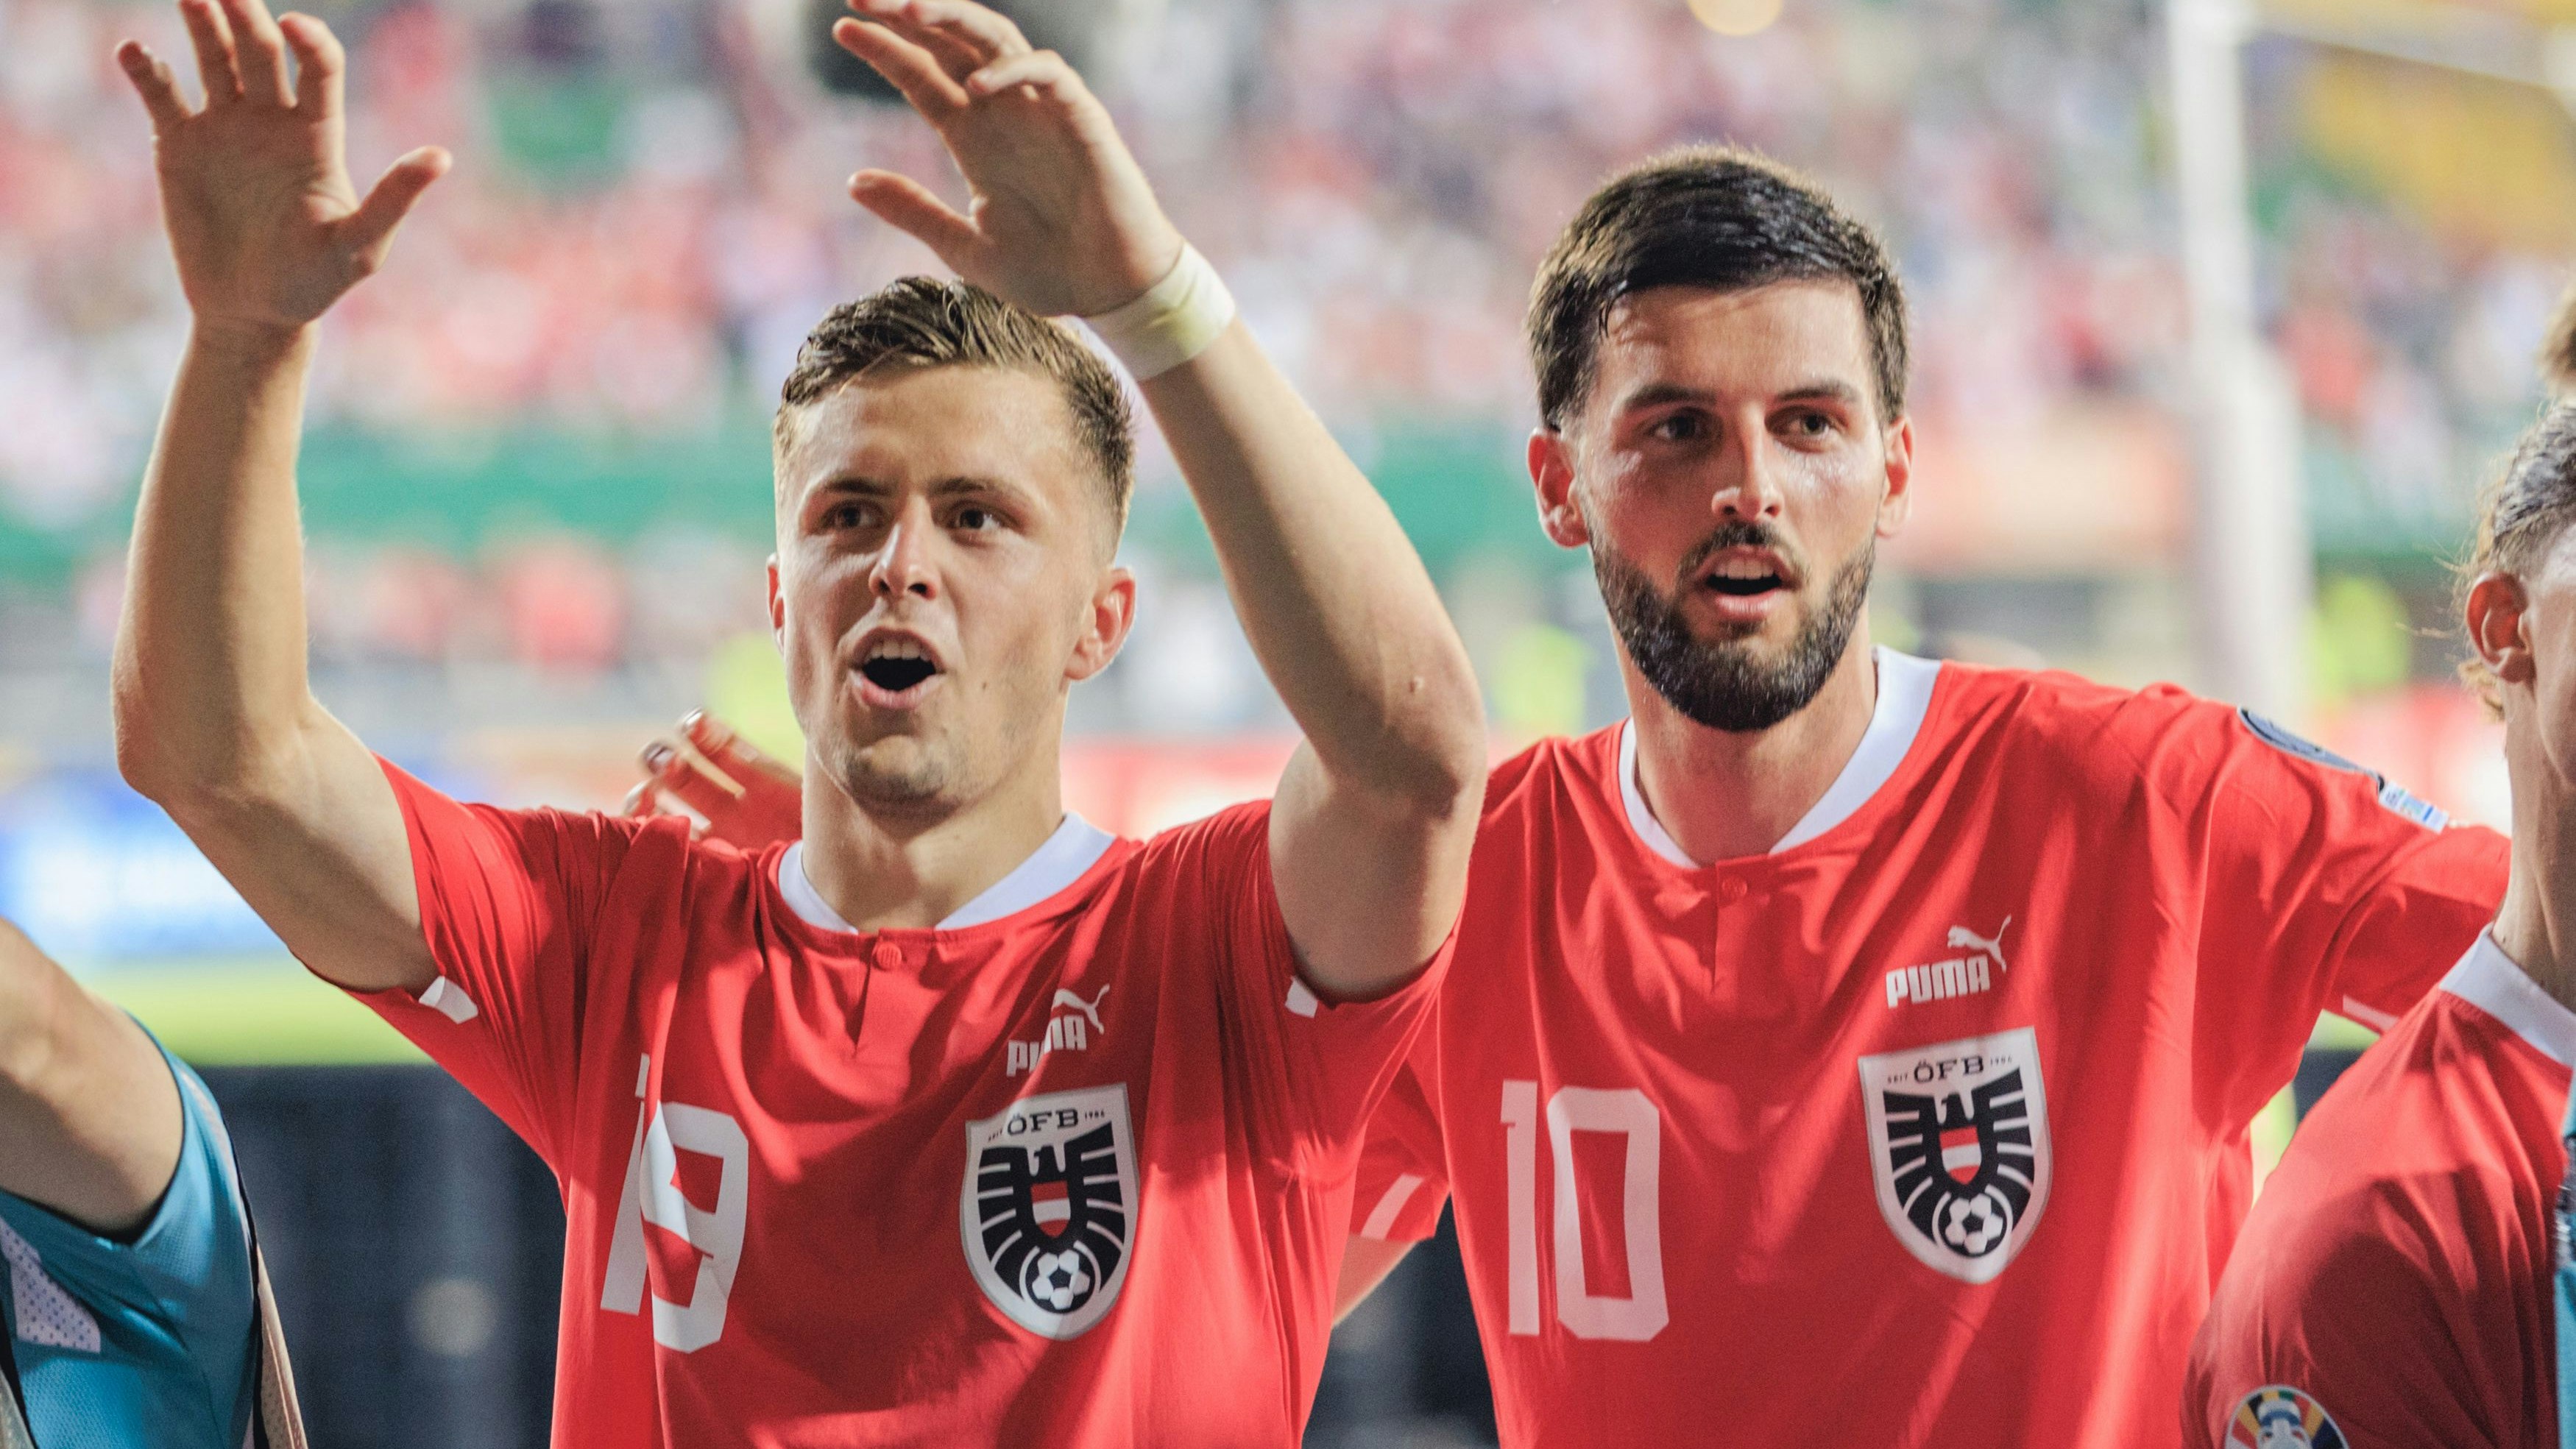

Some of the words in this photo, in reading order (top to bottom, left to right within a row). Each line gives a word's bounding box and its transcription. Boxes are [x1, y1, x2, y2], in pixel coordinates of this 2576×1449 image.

[1886, 956, 1990, 1009] PUMA
[1914, 1055, 1984, 1083] ÖFB
[1007, 1108, 1079, 1136] ÖFB
[1500, 1079, 1670, 1342] 10
